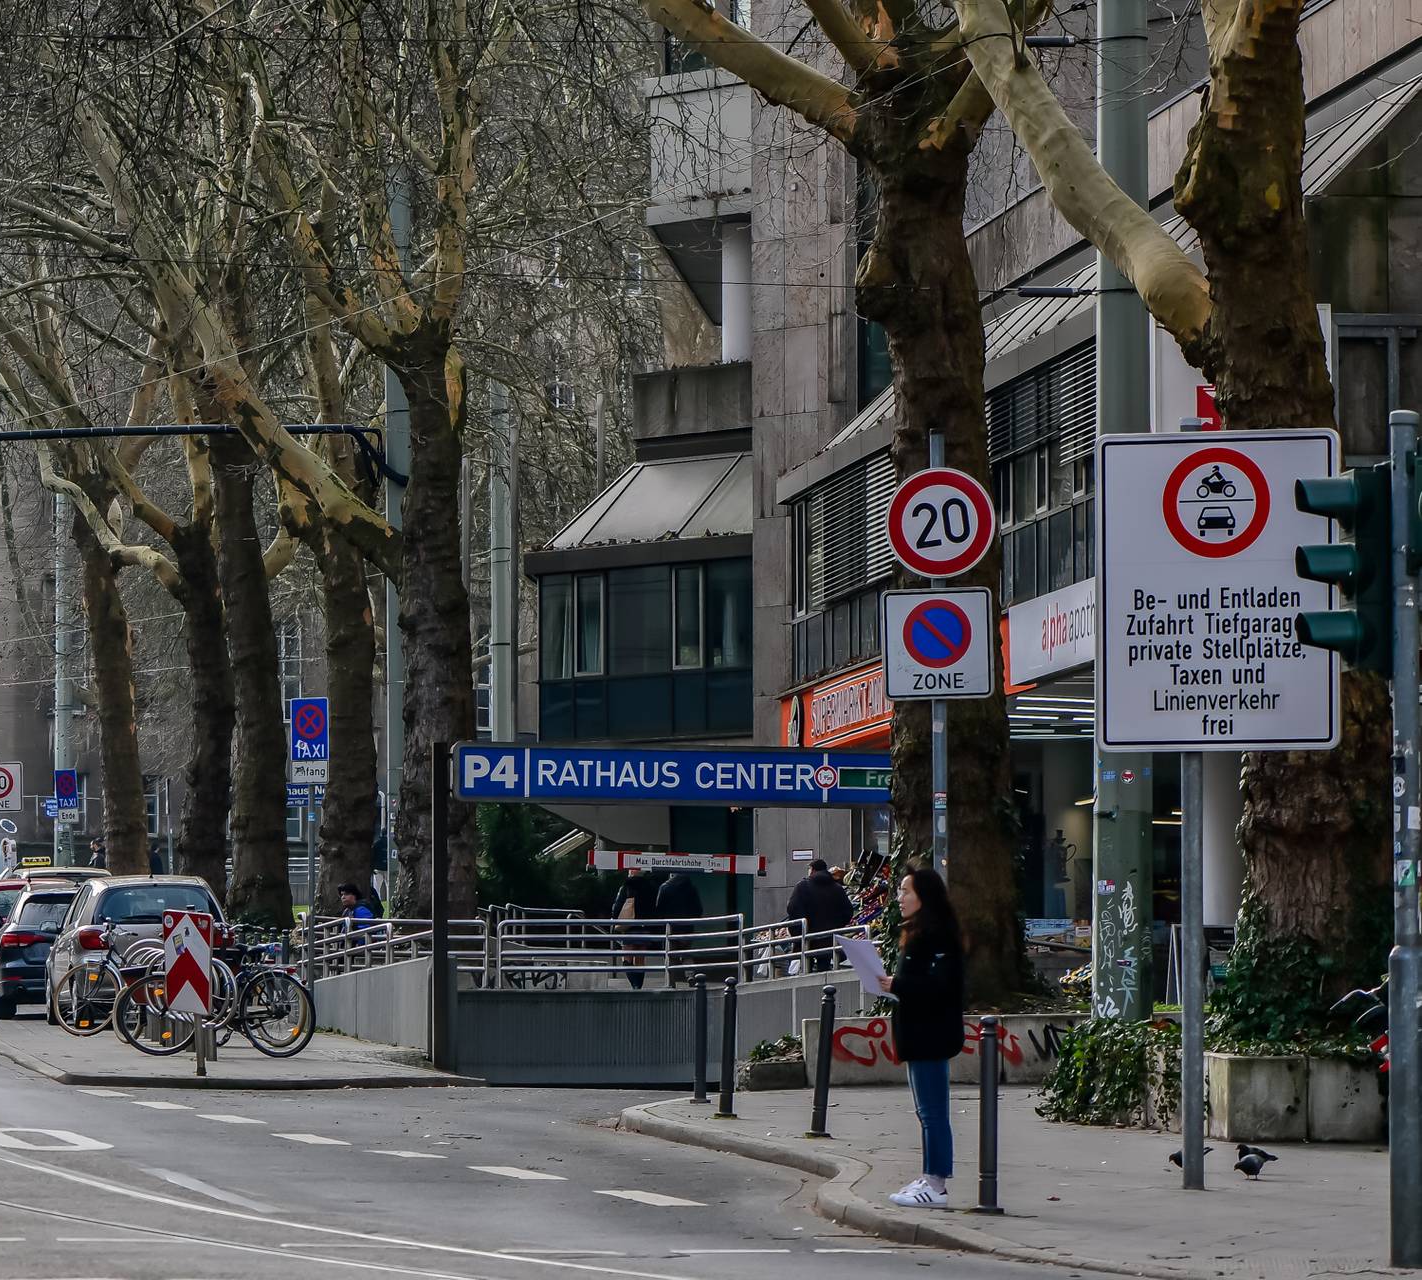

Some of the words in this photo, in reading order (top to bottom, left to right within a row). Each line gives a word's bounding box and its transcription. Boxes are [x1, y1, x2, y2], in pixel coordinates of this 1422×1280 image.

[912, 498, 970, 549] 20
[1134, 589, 1167, 610] Be-
[1178, 588, 1210, 609] und
[1220, 586, 1301, 608] Entladen
[1041, 602, 1067, 661] alpha
[1126, 614, 1194, 636] Zufahrt
[1204, 612, 1293, 639] Tiefgarag
[1128, 639, 1192, 666] private
[1202, 637, 1307, 664] Stellplätze,
[913, 673, 965, 690] ZONE
[1170, 664, 1222, 685] Taxen
[1232, 662, 1265, 684] und
[810, 681, 868, 738] SUPERMARKT
[1153, 688, 1280, 711] Linienverkehr
[1202, 714, 1234, 735] frei
[464, 755, 519, 789] P4
[537, 759, 680, 788] RATHAUS
[695, 763, 815, 791] CENTER
[58, 798, 77, 808] TAXI
[61, 812, 76, 820] Ende
